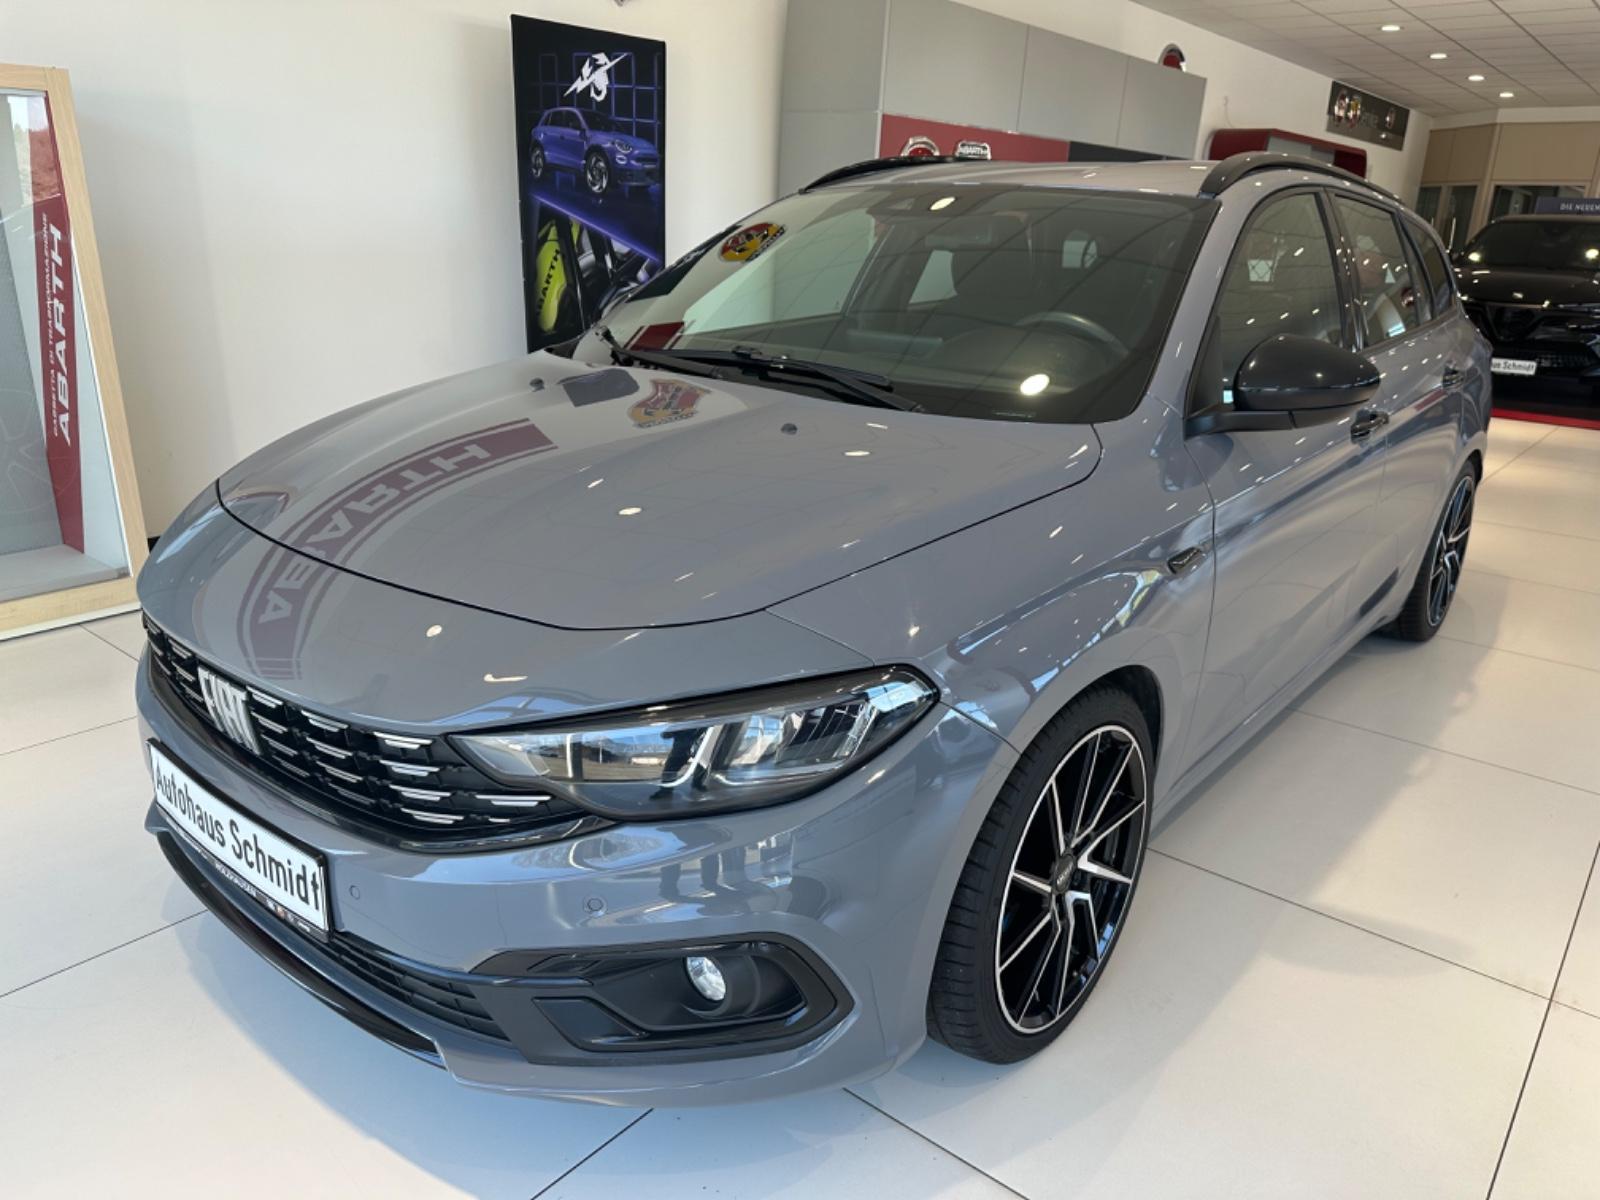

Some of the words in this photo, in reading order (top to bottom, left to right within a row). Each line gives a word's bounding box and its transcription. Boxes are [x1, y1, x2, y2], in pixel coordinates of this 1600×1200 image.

[50, 224, 71, 447] ABARTH
[154, 760, 226, 849] Autohaus
[228, 818, 319, 912] Schmidt
